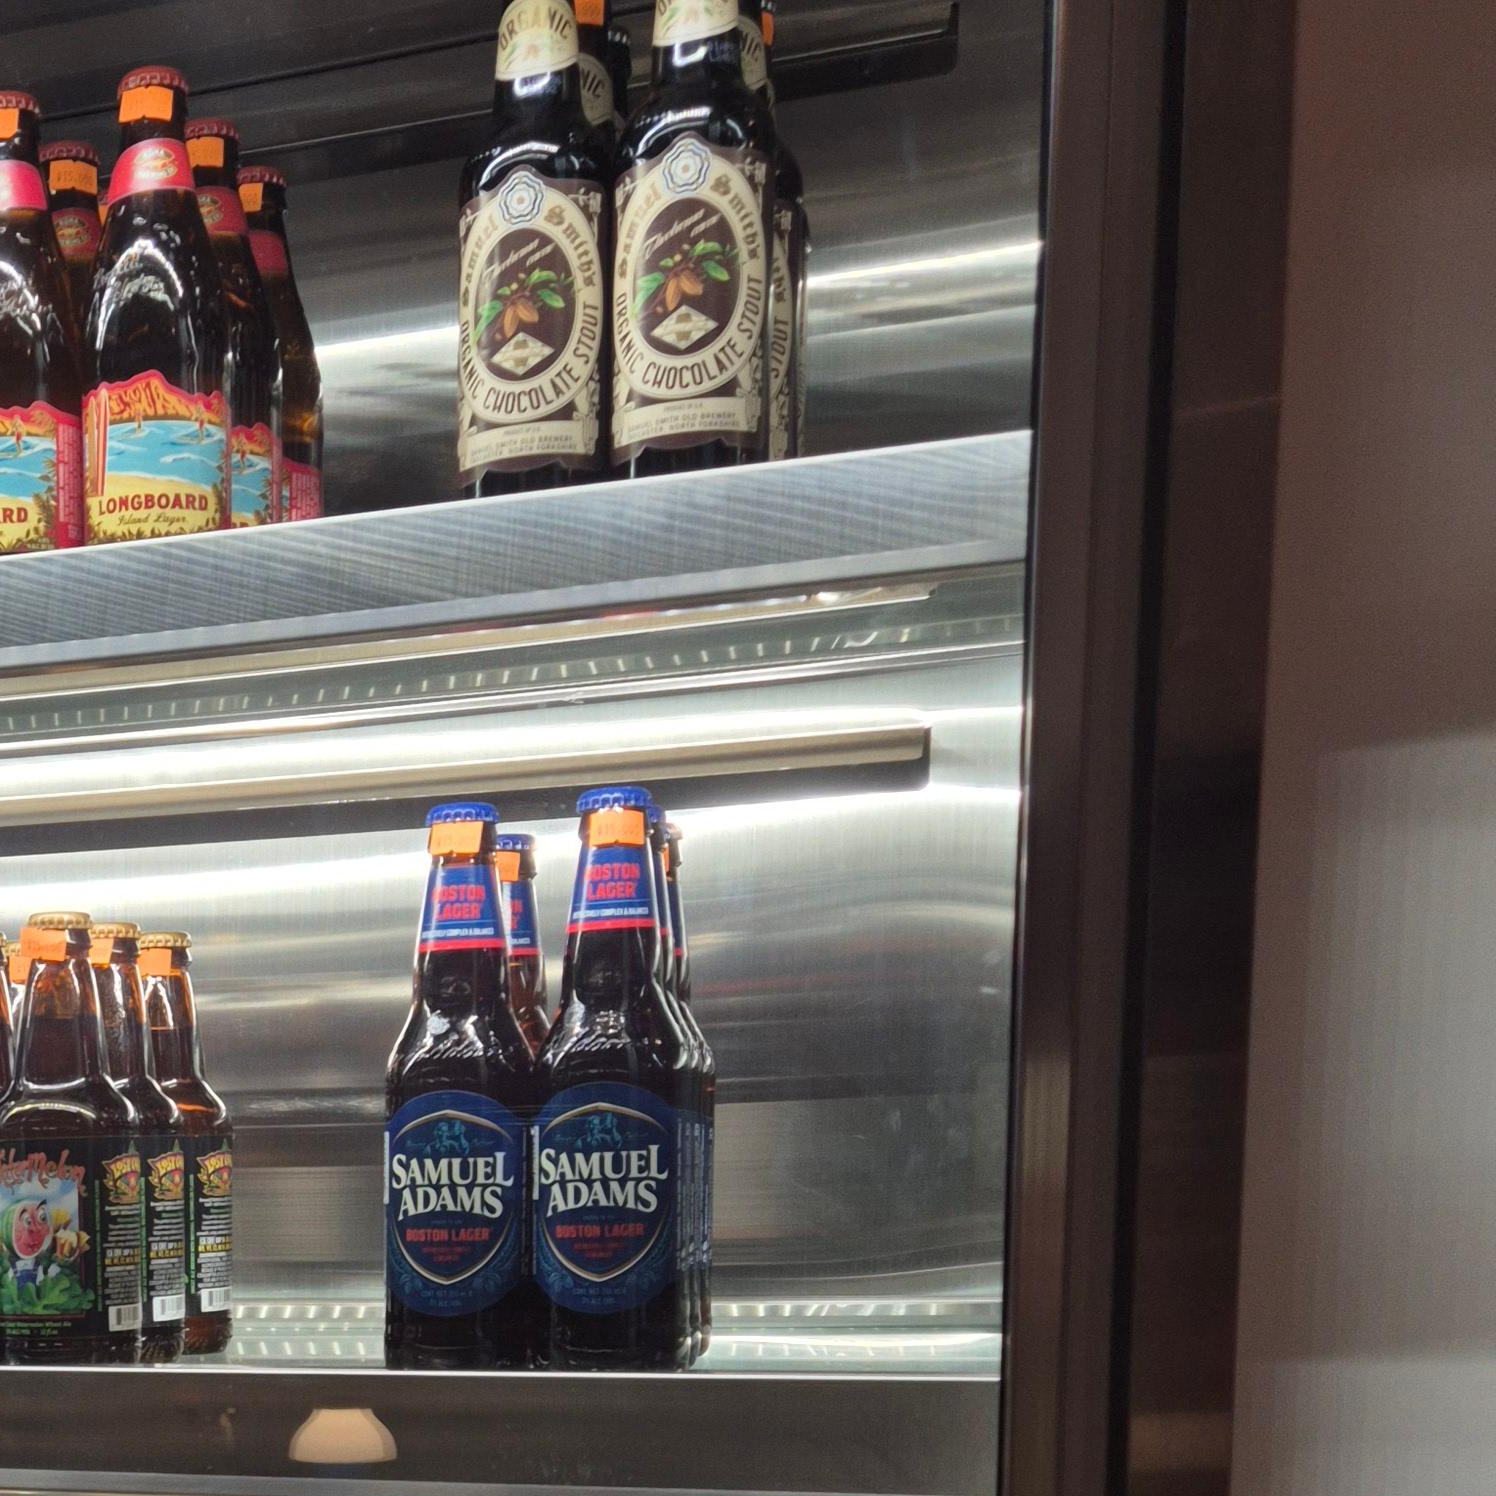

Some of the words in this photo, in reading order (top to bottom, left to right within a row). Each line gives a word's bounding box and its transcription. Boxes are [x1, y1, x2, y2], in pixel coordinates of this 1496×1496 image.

[642, 338, 744, 390] CHOCOLATE
[737, 275, 764, 340] STOUT
[483, 363, 581, 415] CHOCOLATE
[98, 492, 209, 516] LONGBOARD
[584, 863, 640, 880] BOSTON
[431, 884, 486, 902] BOSTON
[587, 881, 636, 900] LAGER
[434, 902, 482, 920] LAGER
[391, 1151, 515, 1190] SAMUEL
[540, 1144, 668, 1185] SAMUEL
[397, 1185, 504, 1221] ADAMS
[545, 1180, 658, 1218] ADAMS
[406, 1227, 449, 1242] BOSTON
[451, 1227, 491, 1242] LAGER
[555, 1224, 601, 1239] BOSTON
[603, 1223, 645, 1238] LAGER
